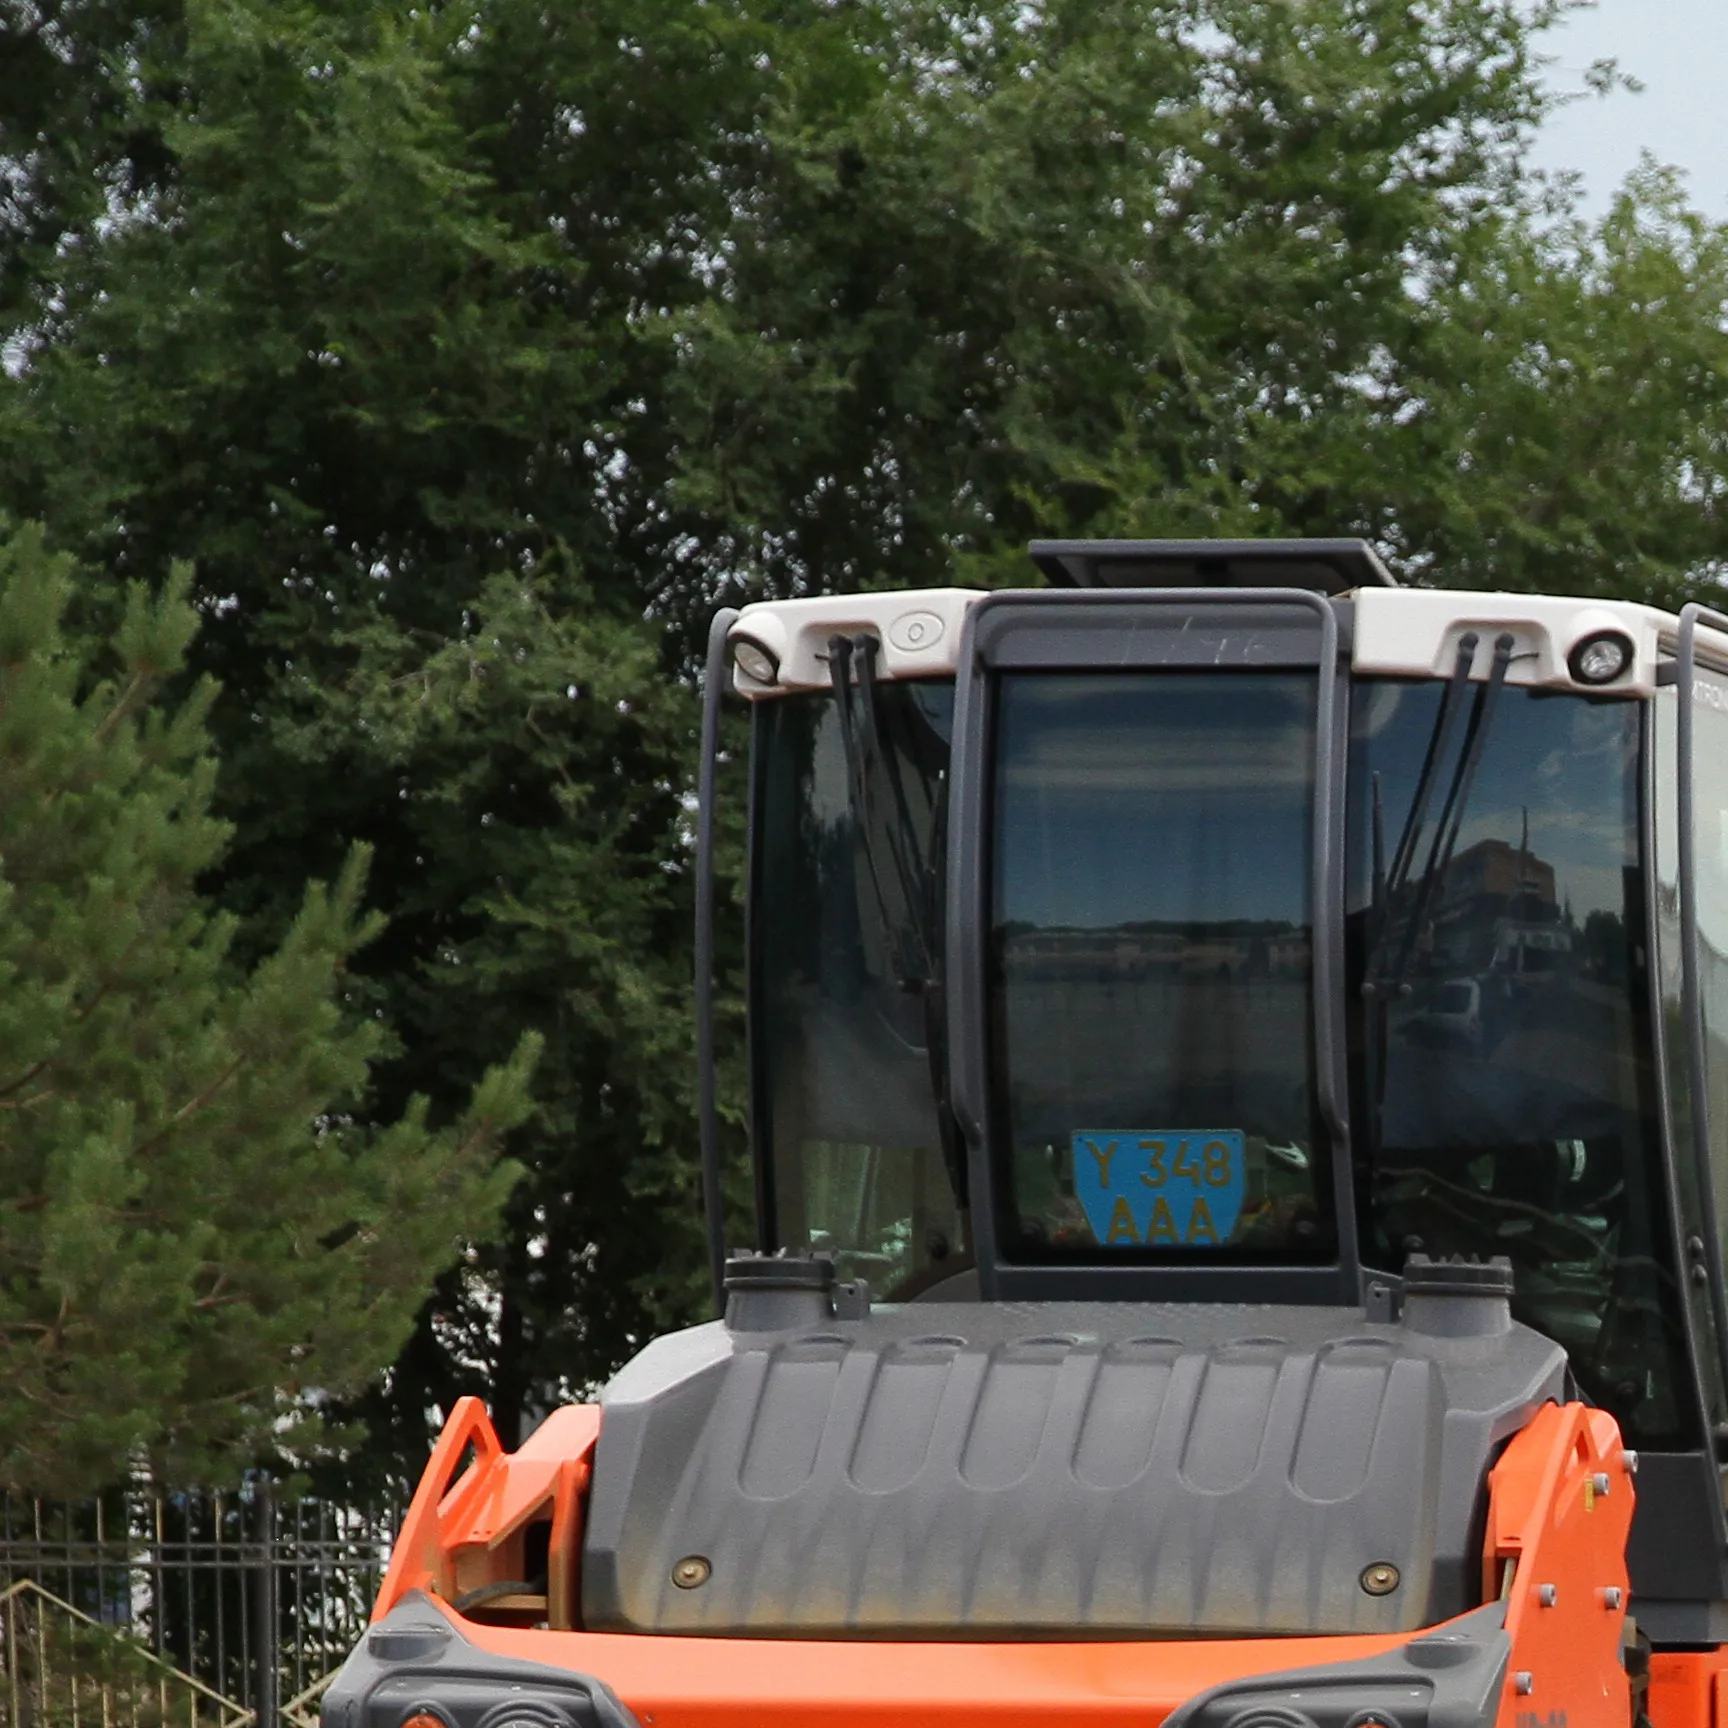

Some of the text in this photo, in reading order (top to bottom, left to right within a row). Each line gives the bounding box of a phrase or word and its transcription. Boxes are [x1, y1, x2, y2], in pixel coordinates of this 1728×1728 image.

[1085, 1139, 1231, 1188] Y 348
[1106, 1195, 1221, 1244] AAA
